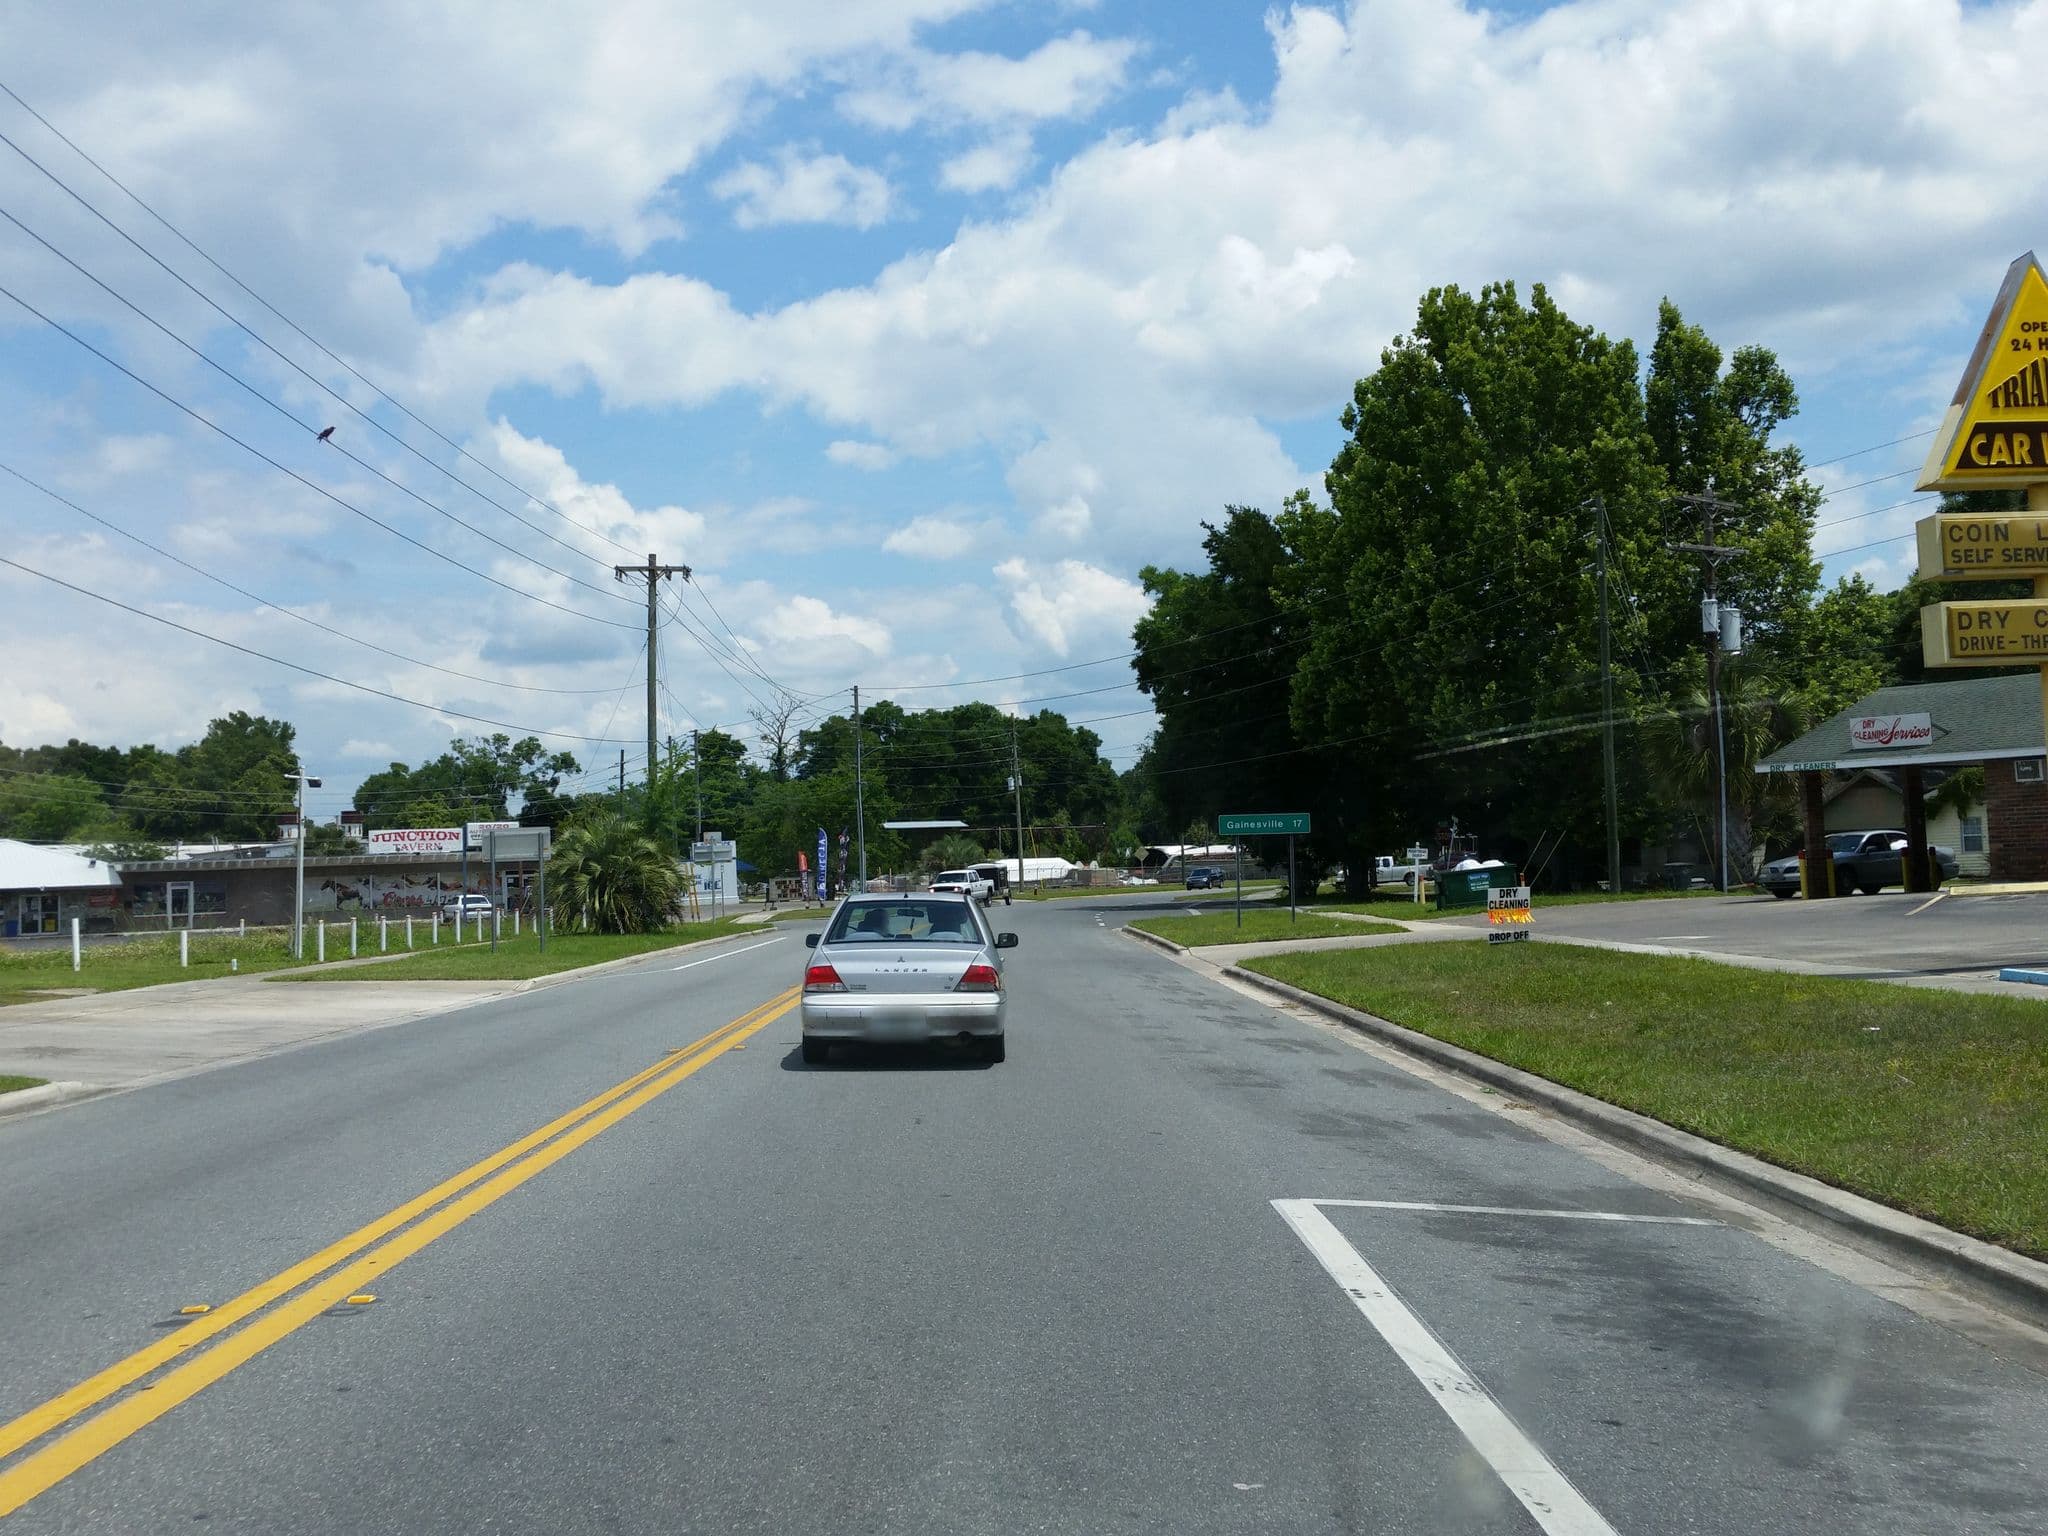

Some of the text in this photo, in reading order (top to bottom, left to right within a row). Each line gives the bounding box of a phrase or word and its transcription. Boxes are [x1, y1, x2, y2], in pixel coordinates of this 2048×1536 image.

[2011, 338, 2032, 352] 24
[1970, 432, 2033, 466] CAR
[1949, 523, 2009, 543] COIN
[1952, 549, 1994, 563] SELF
[1957, 610, 2010, 630] DRY
[1862, 719, 1875, 729] DRY
[1854, 717, 1931, 745] CLEANING Services
[1770, 762, 1836, 773] DRY CLEANERS
[1226, 819, 1303, 829] Gainesville 17
[371, 830, 461, 843] JUNCTION
[393, 842, 443, 851] TAVERN
[1499, 888, 1518, 898] DRY
[1488, 899, 1529, 910] CLEANING
[1489, 930, 1529, 942] DROP OFF
